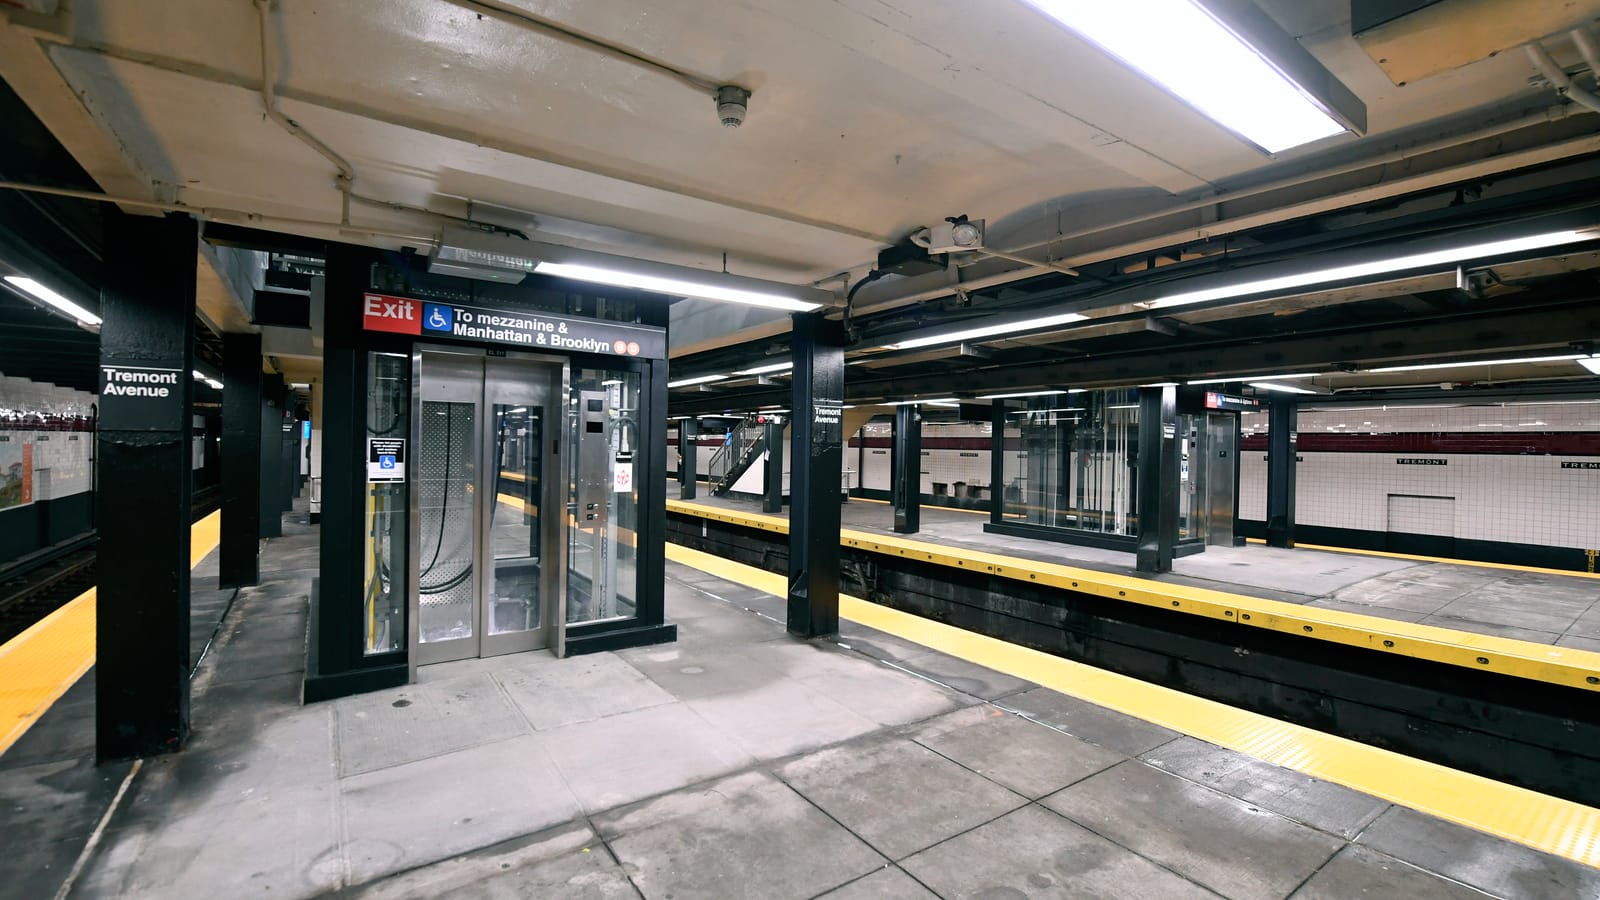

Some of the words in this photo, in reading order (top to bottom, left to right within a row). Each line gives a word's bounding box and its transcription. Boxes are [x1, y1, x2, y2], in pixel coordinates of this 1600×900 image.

[364, 295, 414, 321] Exit
[454, 308, 473, 323] To
[477, 313, 554, 332] mezzanine
[558, 322, 568, 334] &
[453, 322, 532, 343] Manhattan
[536, 332, 547, 345] &
[550, 333, 610, 353] Brooklyn
[103, 368, 178, 385] Tremont
[103, 382, 169, 397] Avenue
[814, 407, 842, 416] Tremont
[814, 415, 839, 424] Avenue
